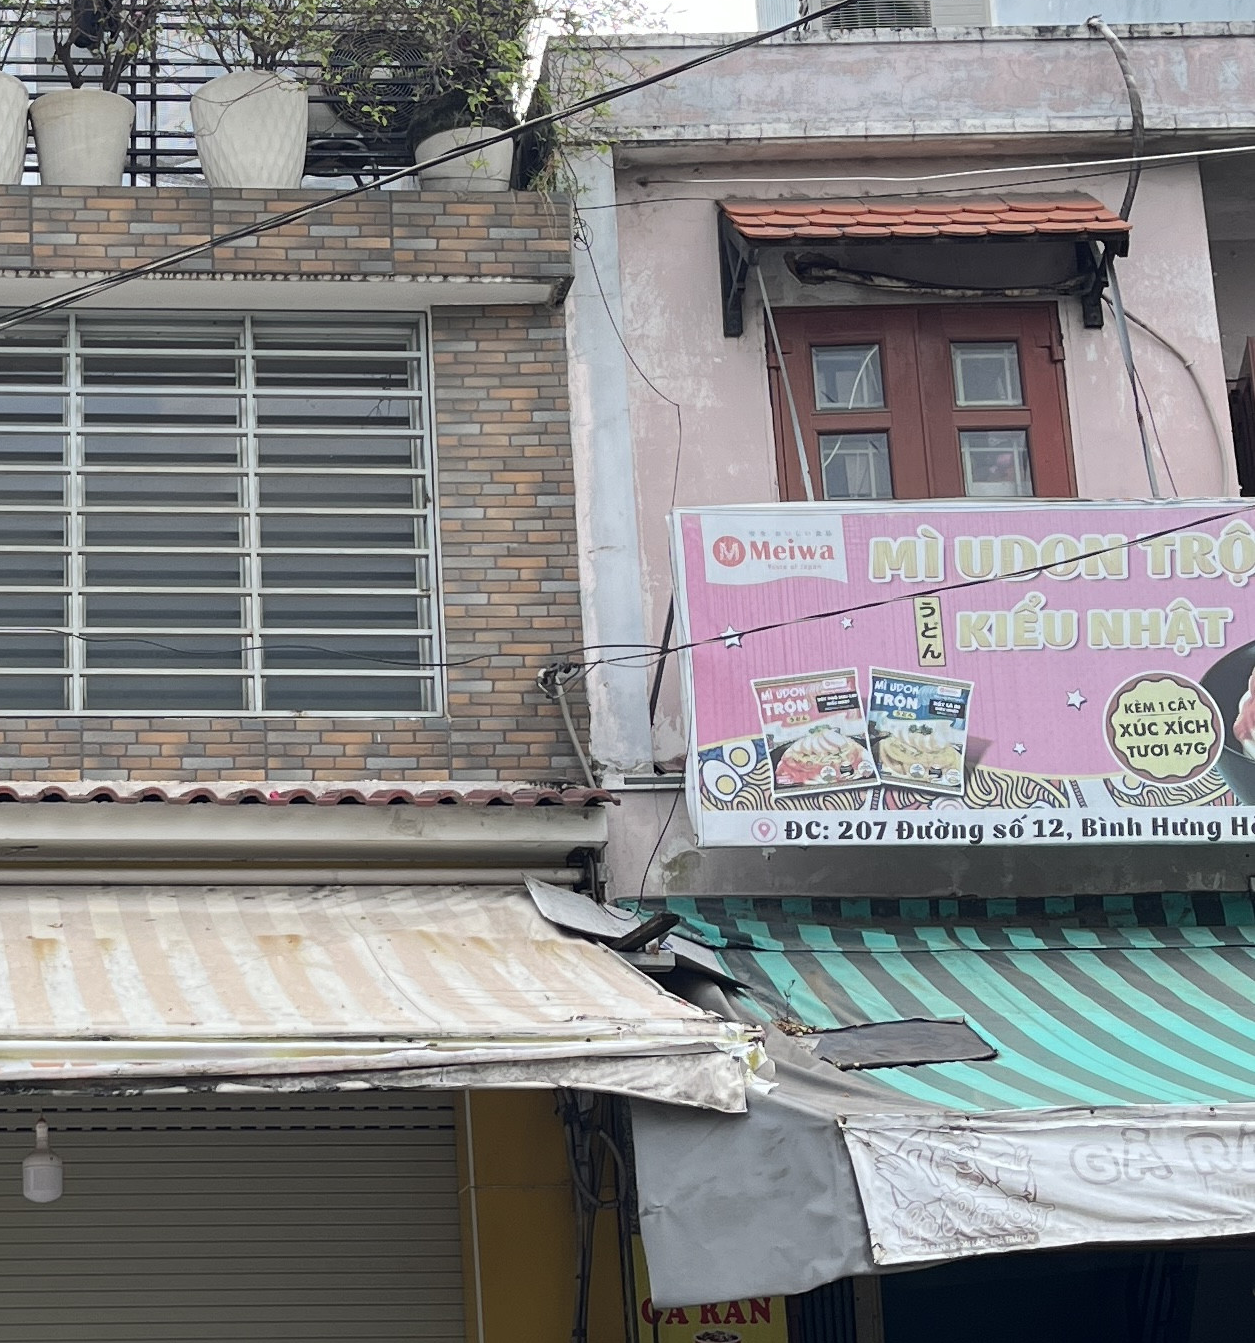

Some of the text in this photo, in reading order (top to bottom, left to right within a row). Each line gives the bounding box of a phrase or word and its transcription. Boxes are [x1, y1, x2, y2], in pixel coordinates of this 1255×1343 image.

[749, 538, 835, 561] Meiwa
[872, 526, 940, 579] MÌ
[957, 535, 1124, 578] UDON
[918, 600, 942, 659] うどん
[959, 594, 1231, 654] KIỂU NHẬT
[776, 687, 806, 700] UDON
[874, 679, 920, 696] MÌ UDON
[1124, 697, 1197, 714] KÈM 1 CÂY
[1118, 716, 1210, 738] XÚC XÍCH
[1126, 742, 1207, 758] TƯƠI 47G
[784, 820, 829, 841] ĐC:
[837, 820, 887, 841] 207
[895, 818, 984, 845] Đường
[992, 814, 1028, 839] số
[1032, 817, 1073, 841] 12,
[1081, 816, 1142, 837] Bình
[1151, 816, 1222, 842] Hưng
[1069, 1127, 1174, 1186] GÀ
